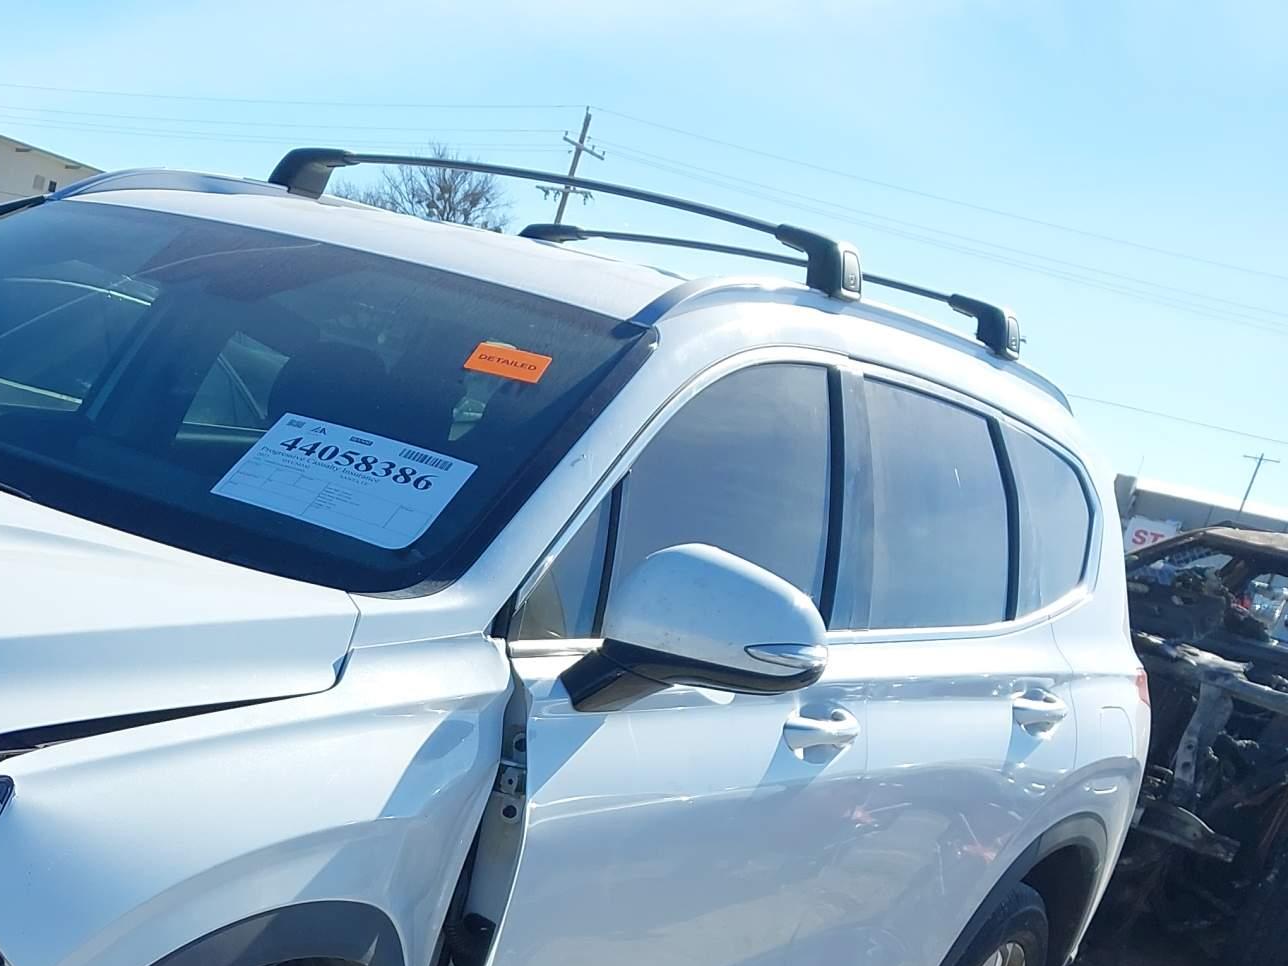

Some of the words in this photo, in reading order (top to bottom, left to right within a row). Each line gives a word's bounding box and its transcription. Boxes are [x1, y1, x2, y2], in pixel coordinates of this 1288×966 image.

[478, 353, 537, 371] DETAILED
[279, 437, 440, 491] 44058386
[306, 457, 339, 473] Casualty
[342, 467, 381, 484] Insurance
